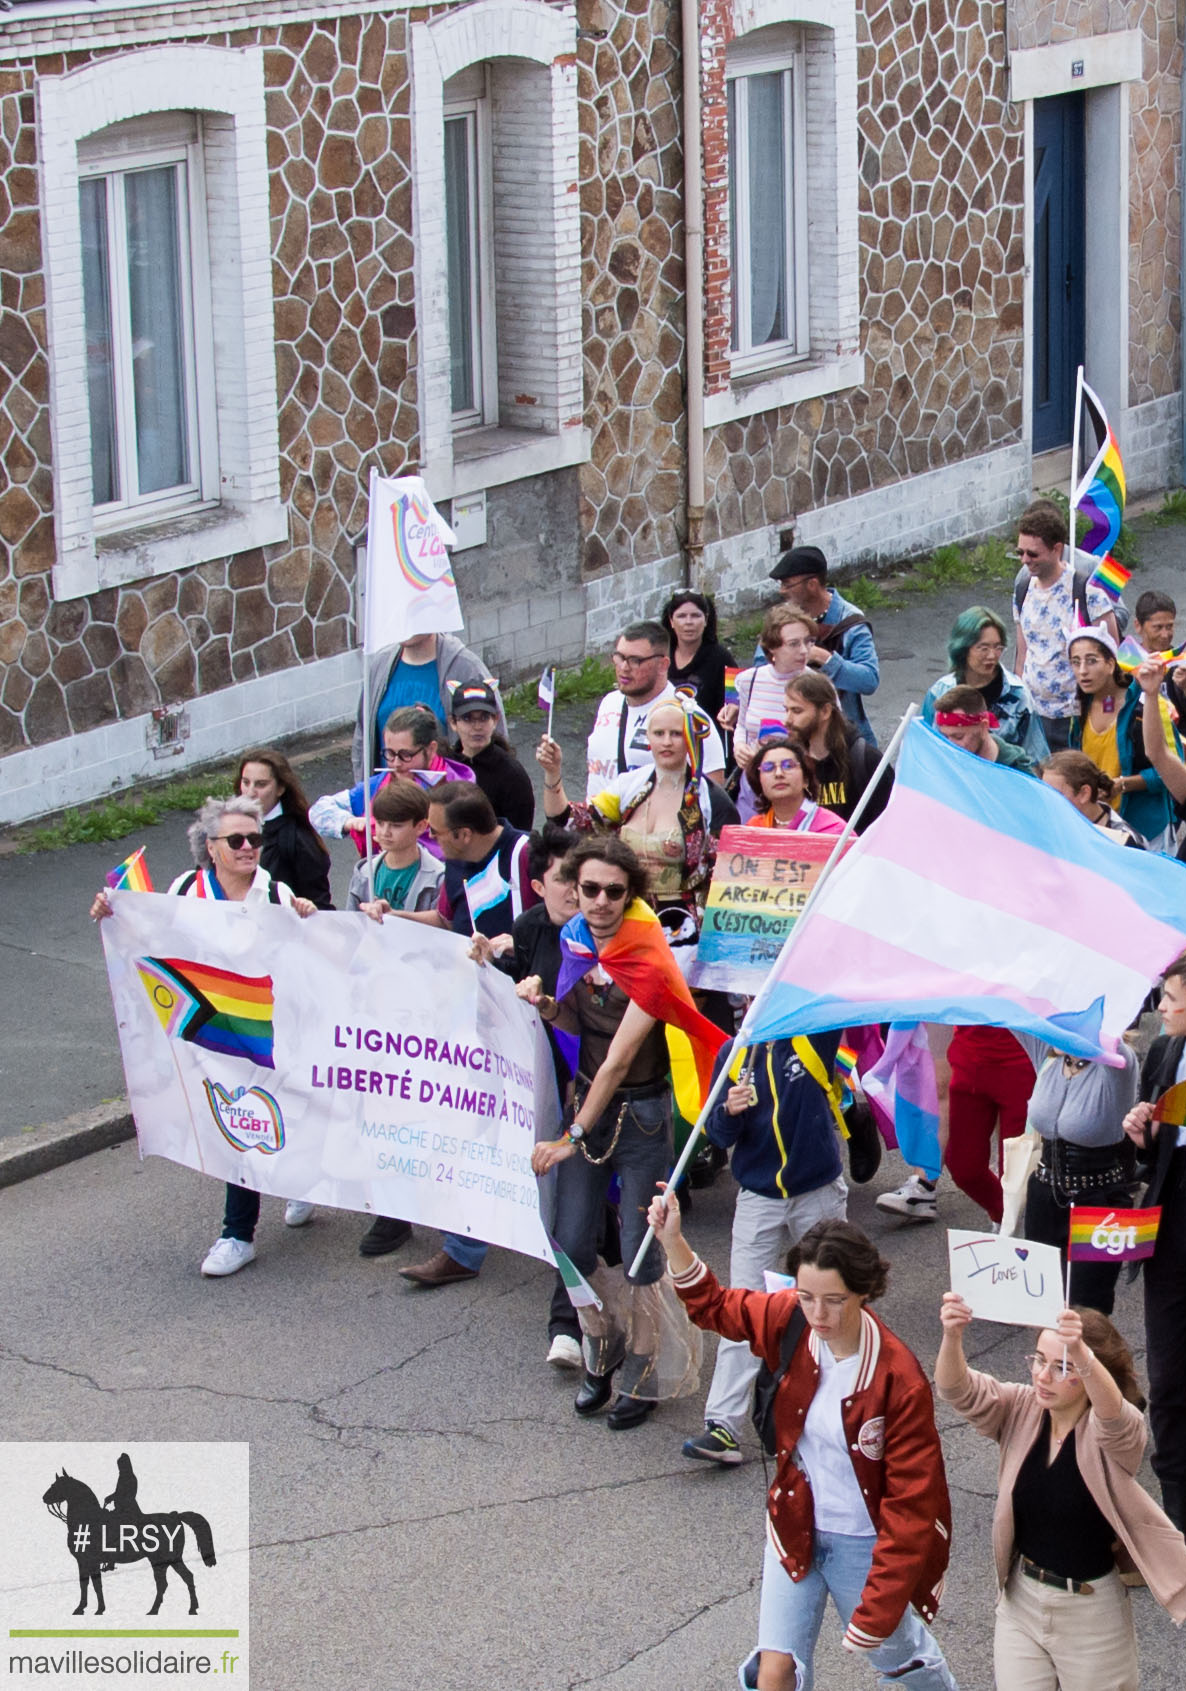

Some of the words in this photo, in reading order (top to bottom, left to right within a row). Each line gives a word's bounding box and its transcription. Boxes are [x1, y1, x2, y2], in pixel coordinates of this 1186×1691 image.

[729, 853, 760, 878] ON
[773, 859, 811, 883] EST
[334, 1025, 492, 1073] L'IGNORANCE
[311, 1064, 413, 1100] LIBERTÉ
[419, 1079, 496, 1118] D'AIMER
[219, 1101, 255, 1119] Centre
[230, 1115, 271, 1133] LGBT
[361, 1120, 428, 1149] MARCHE
[432, 1133, 457, 1156] DES
[377, 1152, 432, 1179] SAMEDI
[436, 1162, 454, 1184] 24
[457, 1170, 519, 1202] SEPTEMBRE
[1091, 1226, 1137, 1255] cgt
[992, 1266, 1018, 1285] LOVE
[1023, 1269, 1045, 1298] U
